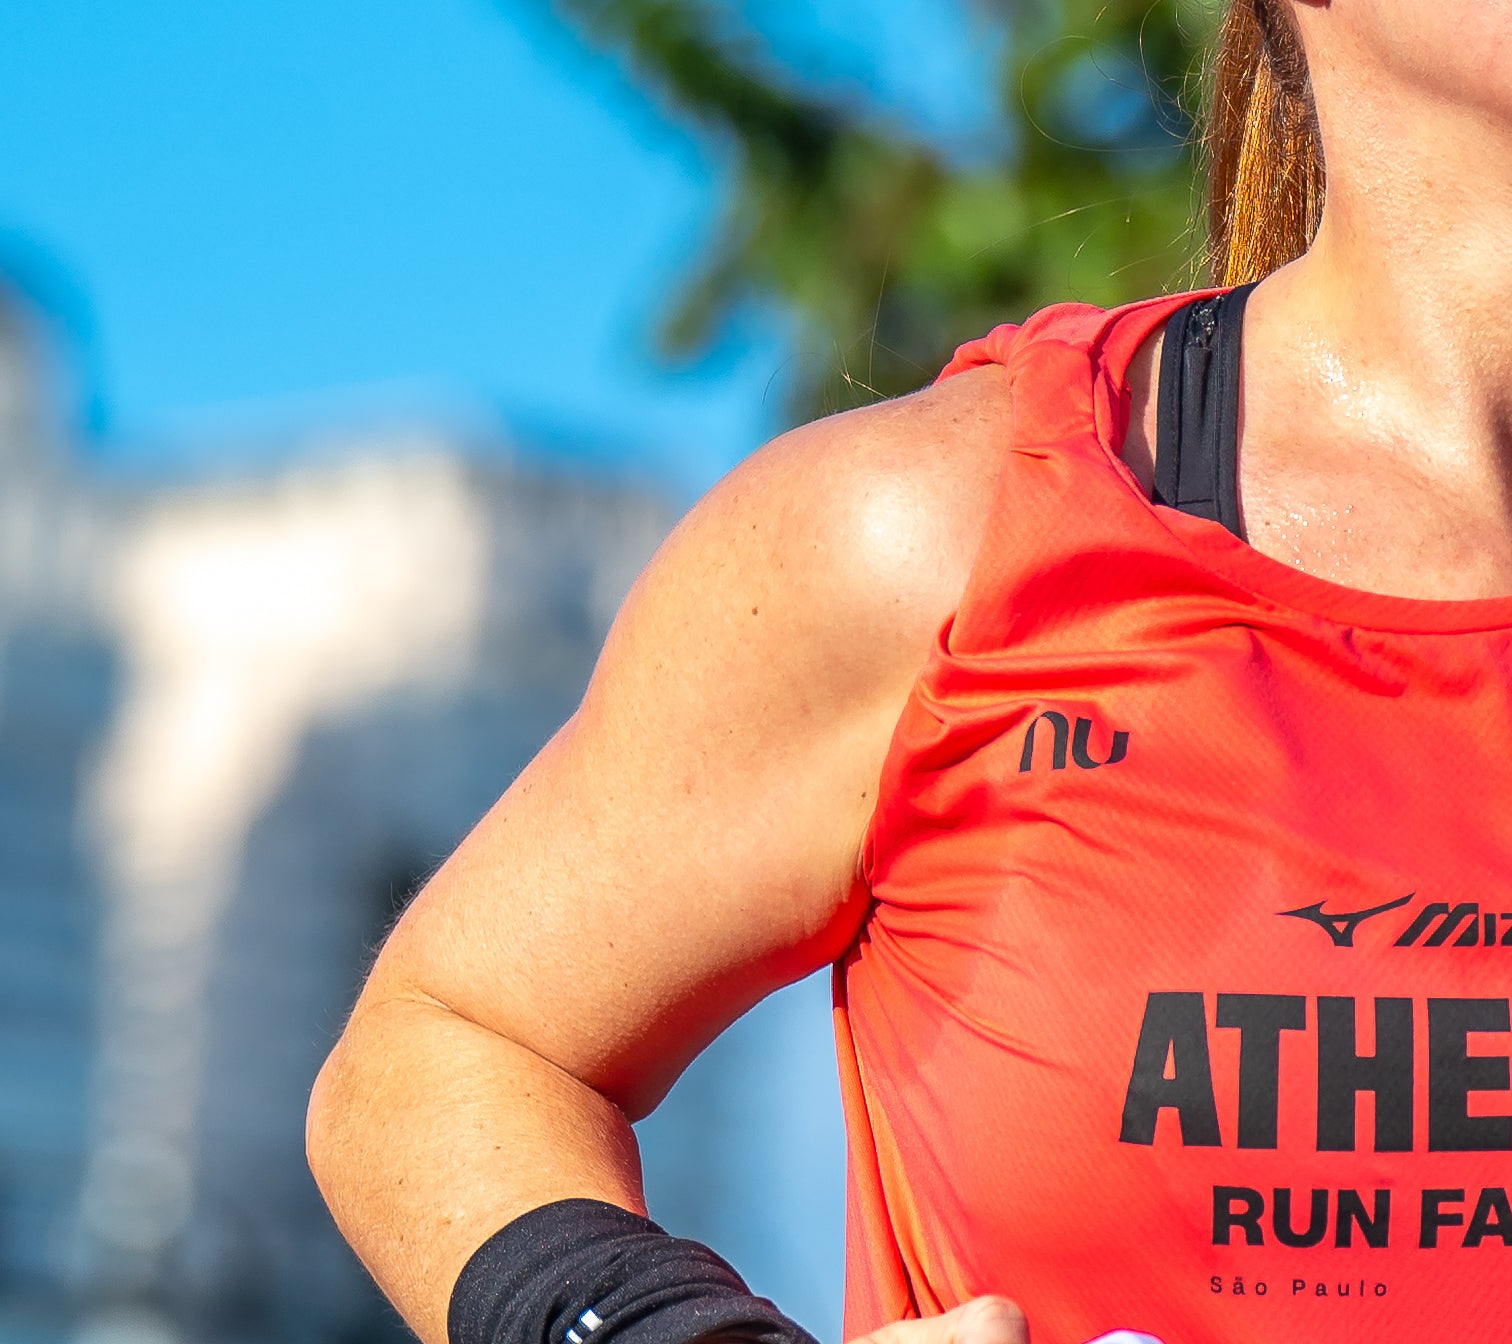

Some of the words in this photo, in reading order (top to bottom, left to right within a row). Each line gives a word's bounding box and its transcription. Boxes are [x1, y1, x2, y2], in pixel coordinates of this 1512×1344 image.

[1211, 1184, 1391, 1250] RUN
[1209, 1274, 1269, 1296] São
[1292, 1277, 1388, 1298] Paulo
